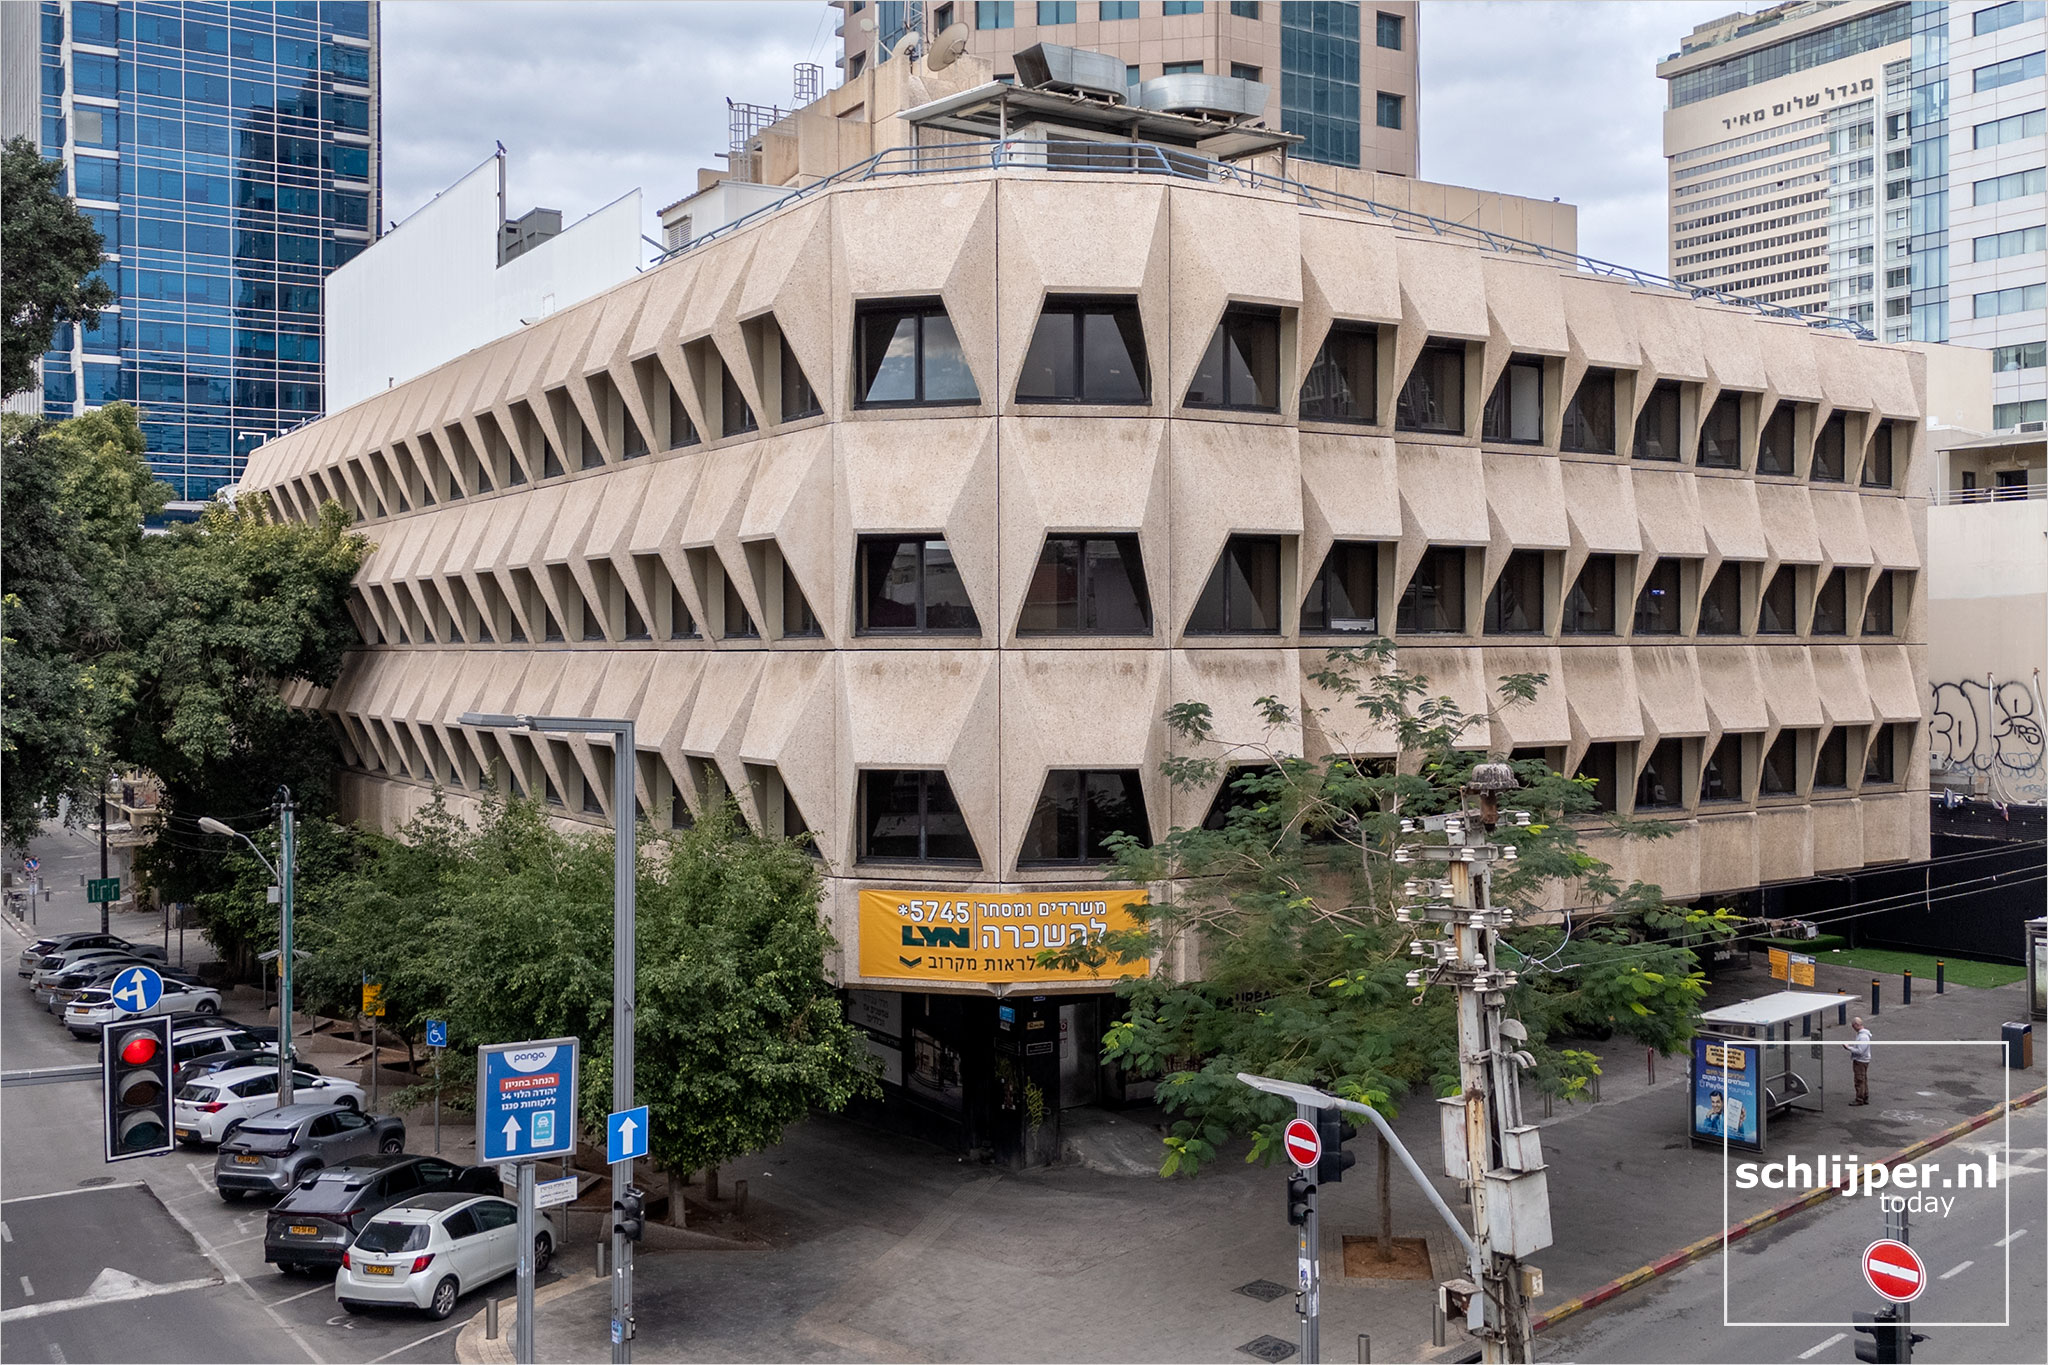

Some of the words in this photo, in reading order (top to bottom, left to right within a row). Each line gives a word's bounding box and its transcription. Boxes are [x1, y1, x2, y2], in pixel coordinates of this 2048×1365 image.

[1825, 78, 1874, 100] מגדל
[1772, 93, 1820, 117] שלום
[1722, 109, 1765, 130] מאיר
[978, 902, 1032, 918] ומסחר
[1038, 900, 1107, 917] משרדים
[901, 925, 971, 949] LYN
[982, 917, 1108, 949] להשכרה
[928, 955, 977, 972] מקרוב
[984, 955, 1036, 972] לראות
[505, 1079, 531, 1089] בחניון
[532, 1076, 555, 1085] הנחה
[513, 1089, 531, 1099] הלוי
[532, 1087, 557, 1097] יהודה
[501, 1102, 519, 1111] פנגו
[520, 1097, 557, 1109] ללקוחות
